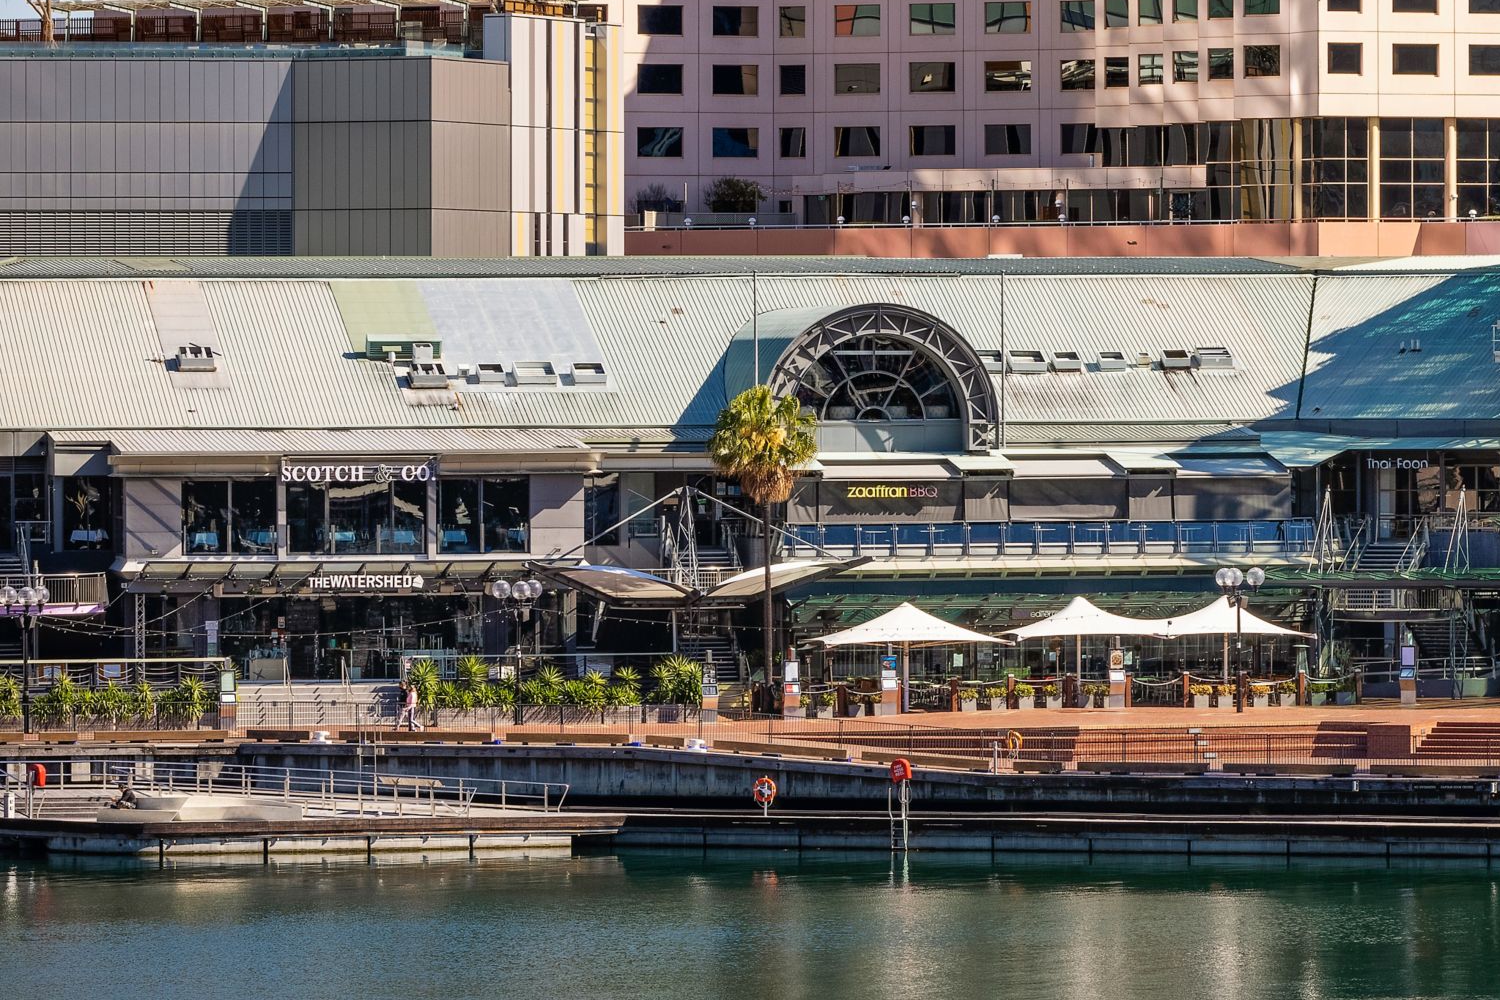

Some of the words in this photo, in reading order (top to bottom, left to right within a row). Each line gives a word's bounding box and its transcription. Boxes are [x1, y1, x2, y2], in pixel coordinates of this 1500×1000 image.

[1367, 457, 1392, 469] Thai
[1396, 457, 1429, 469] Foon
[281, 465, 365, 482] SCOTCH
[374, 463, 393, 483] &
[401, 464, 436, 482] CO.
[909, 485, 938, 498] BBQ
